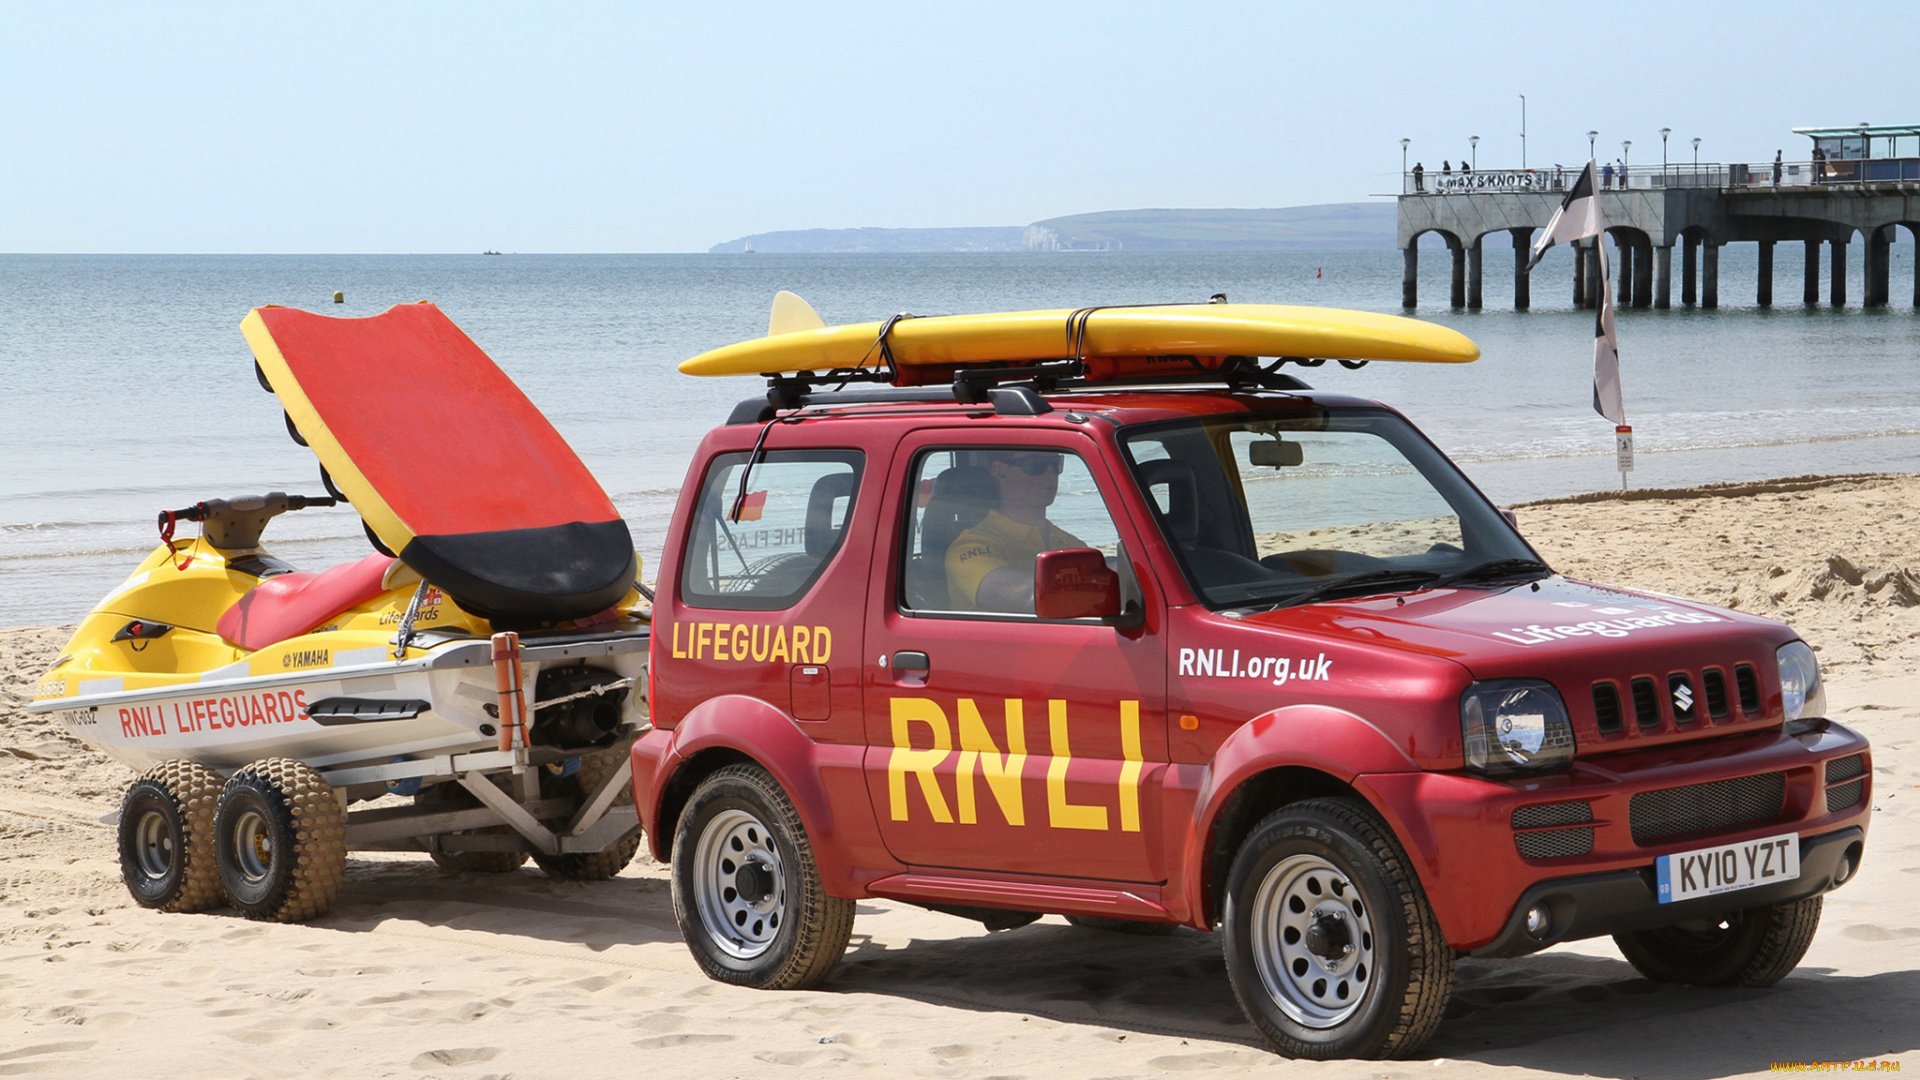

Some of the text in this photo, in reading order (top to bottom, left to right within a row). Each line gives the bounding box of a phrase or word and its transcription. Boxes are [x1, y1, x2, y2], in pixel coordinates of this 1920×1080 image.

[1447, 176, 1473, 188] MAX
[1488, 174, 1532, 187] KNOTS
[959, 545, 990, 563] RNLI
[379, 607, 439, 626] Lifeards
[1491, 610, 1722, 645] Lifeguards
[293, 649, 329, 668] YAMAHA
[672, 622, 832, 664] LIFEGUARD
[1179, 648, 1333, 686] RNLI.org.uk
[118, 689, 310, 738] RNLI LIFEGUARDS
[888, 697, 1144, 833] RNLI
[1680, 839, 1790, 893] KY10 YZT
[1659, 883, 1670, 894] GB
